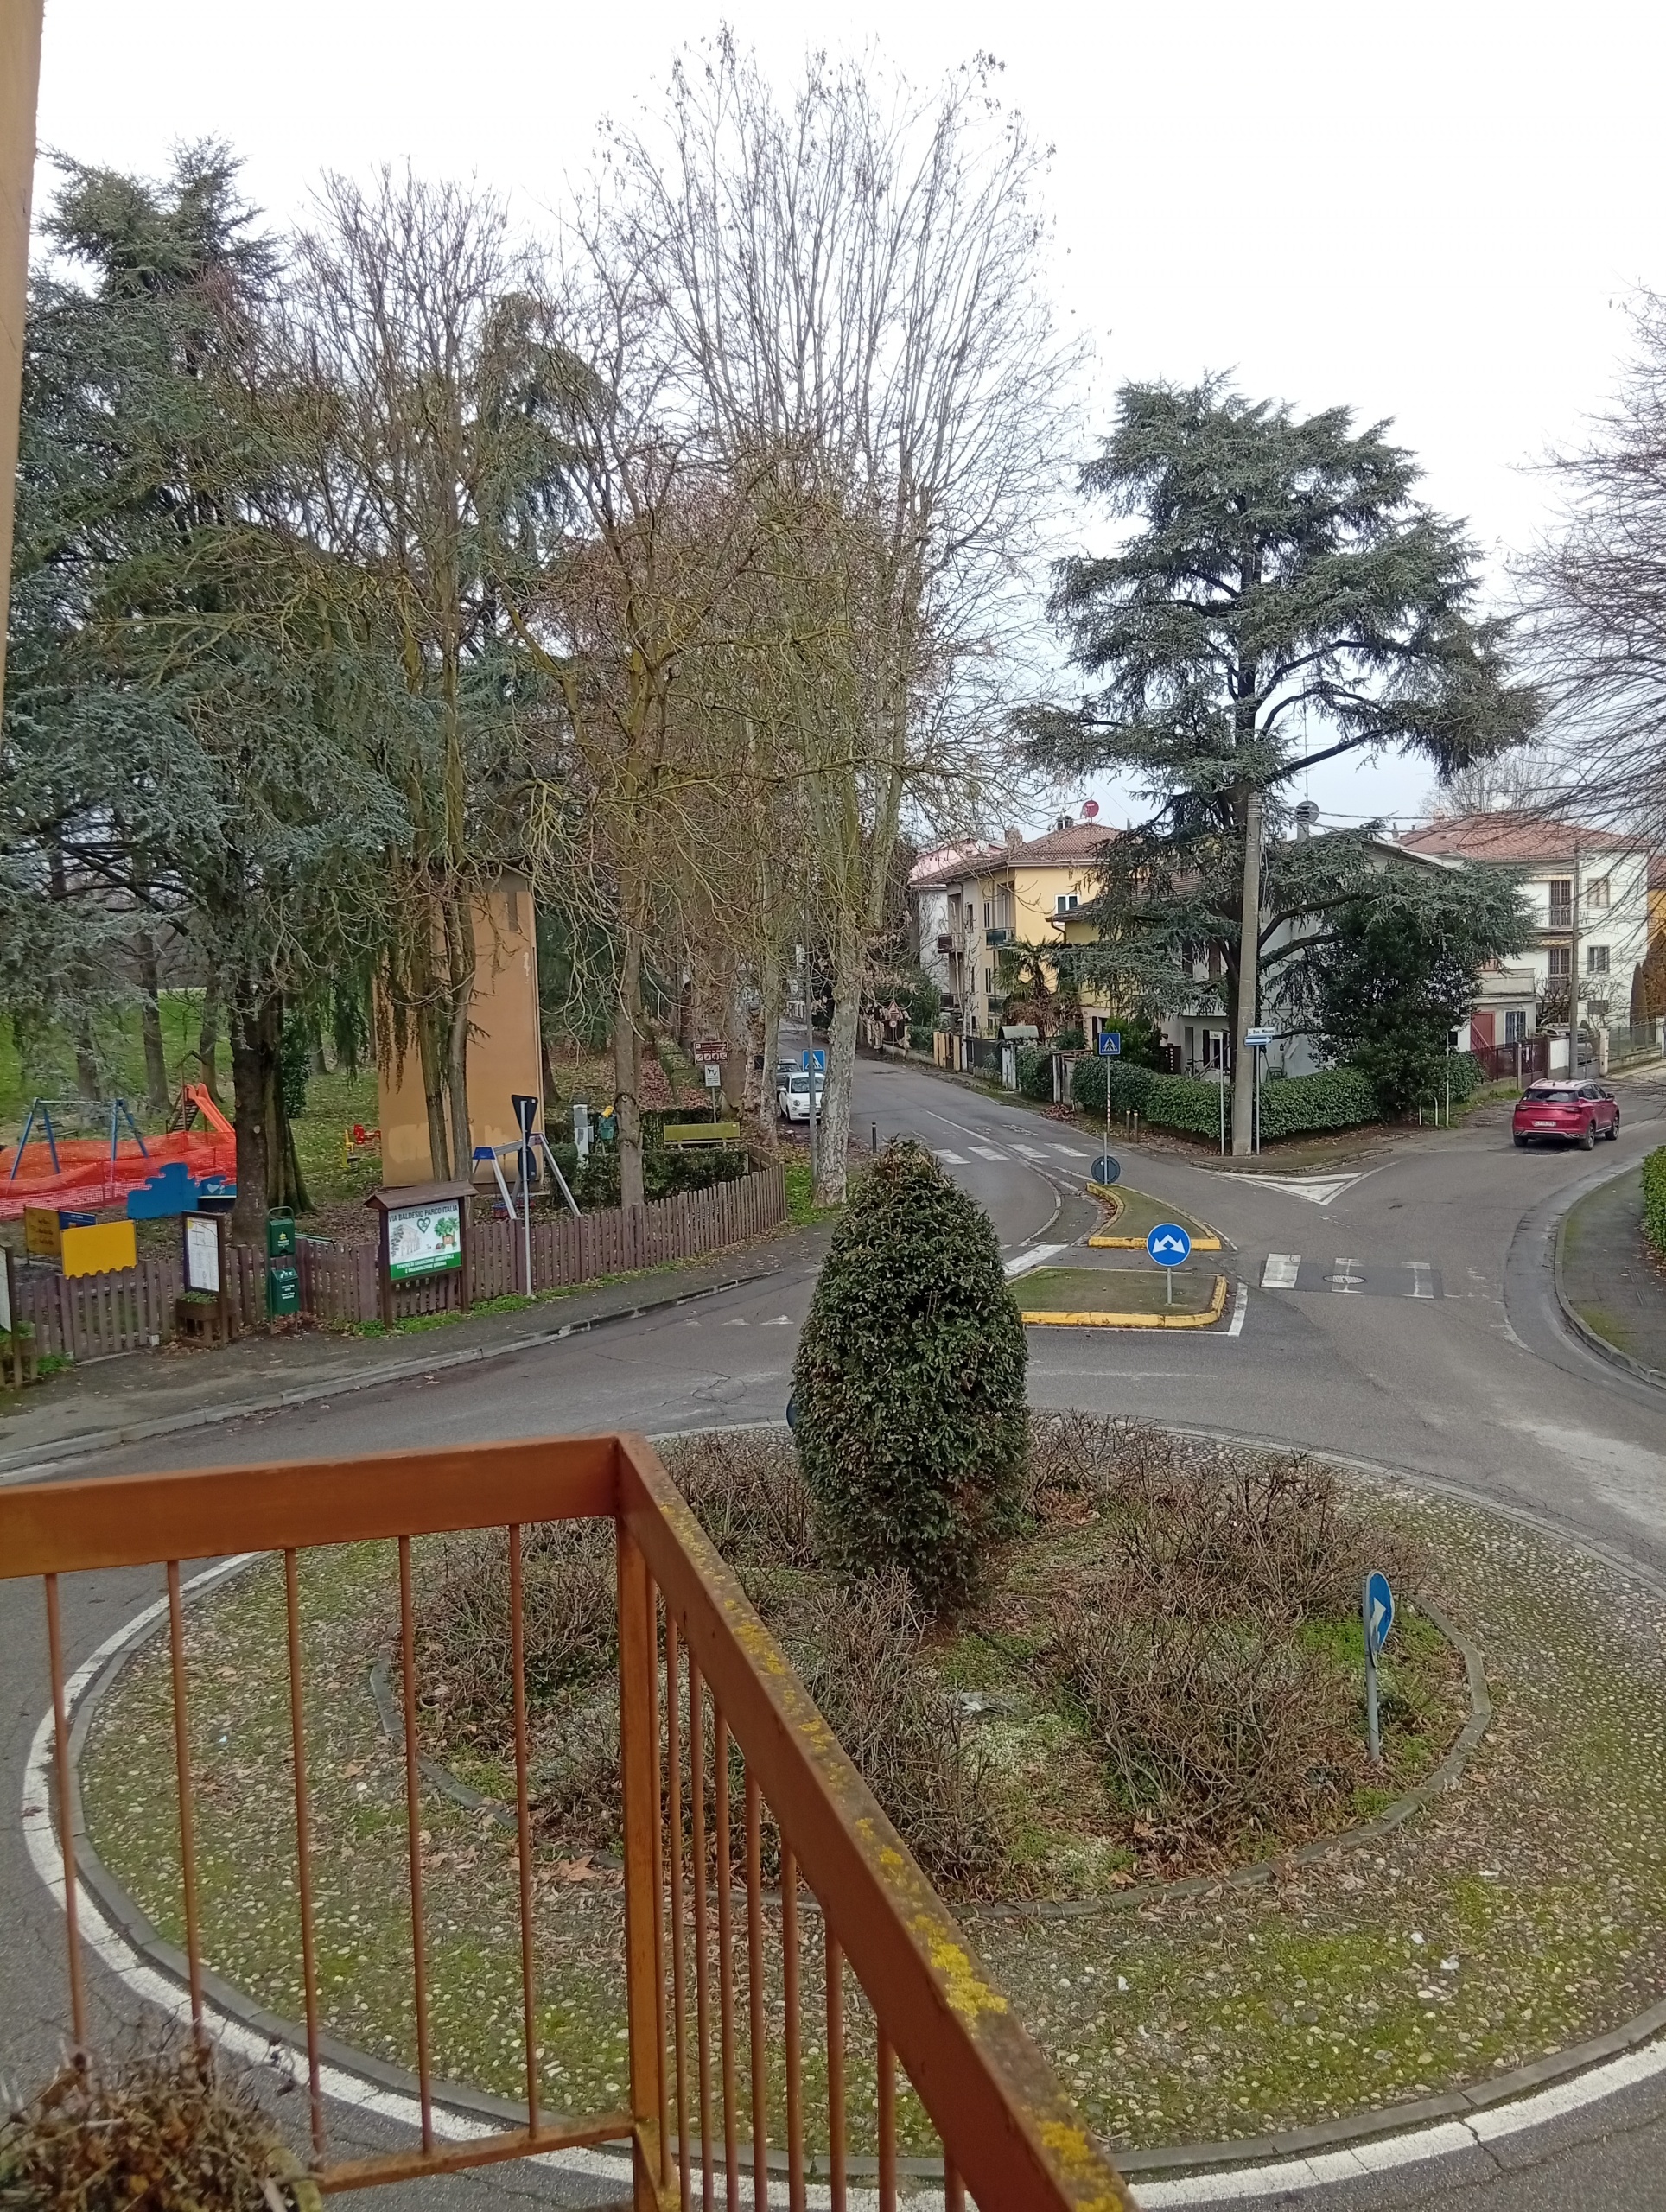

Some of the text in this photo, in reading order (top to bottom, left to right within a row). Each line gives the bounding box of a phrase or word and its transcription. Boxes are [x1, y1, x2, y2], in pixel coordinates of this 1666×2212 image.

[398, 1211, 423, 1221] BALDESIO
[424, 1207, 442, 1217] PARCO
[442, 1205, 458, 1213] ITALIA
